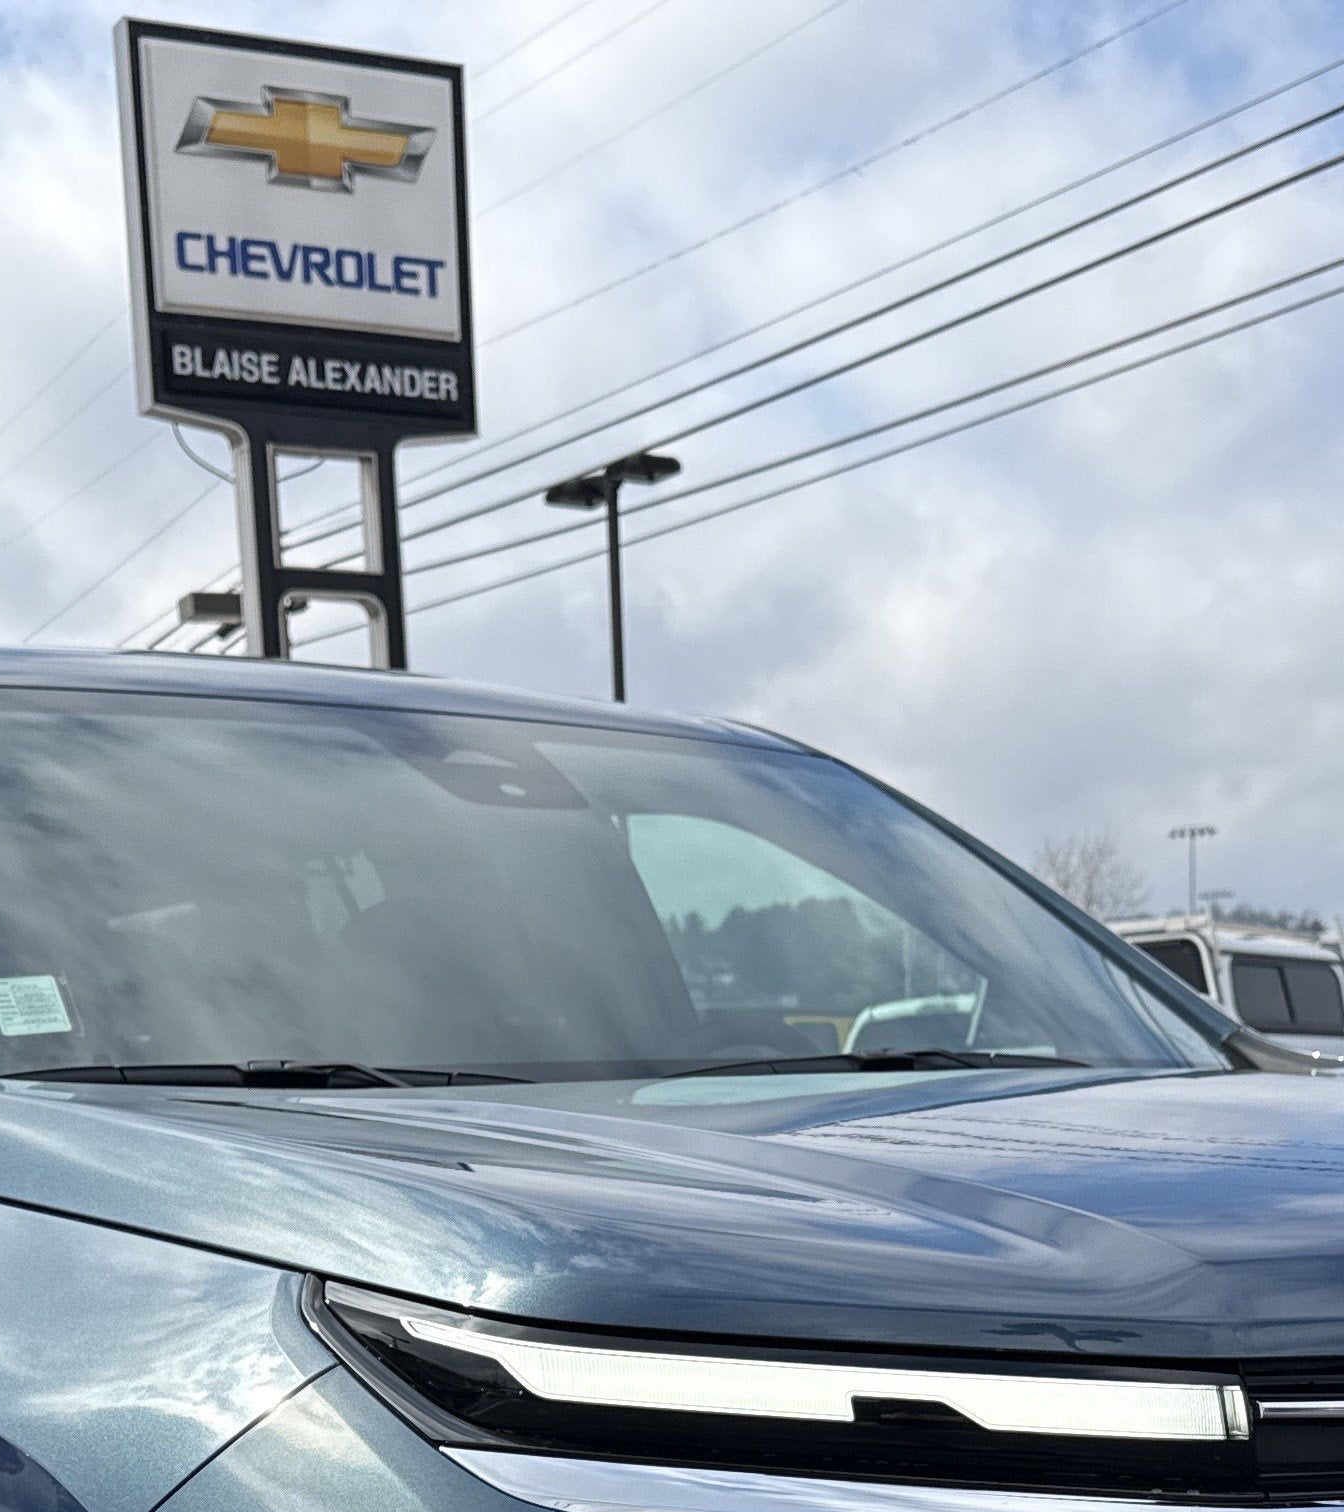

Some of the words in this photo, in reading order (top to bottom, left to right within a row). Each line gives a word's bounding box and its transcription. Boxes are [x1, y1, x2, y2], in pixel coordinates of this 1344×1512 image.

[175, 230, 446, 298] CHEVROLET
[171, 344, 281, 386] BLAISE
[287, 354, 458, 402] ALEXANDER
